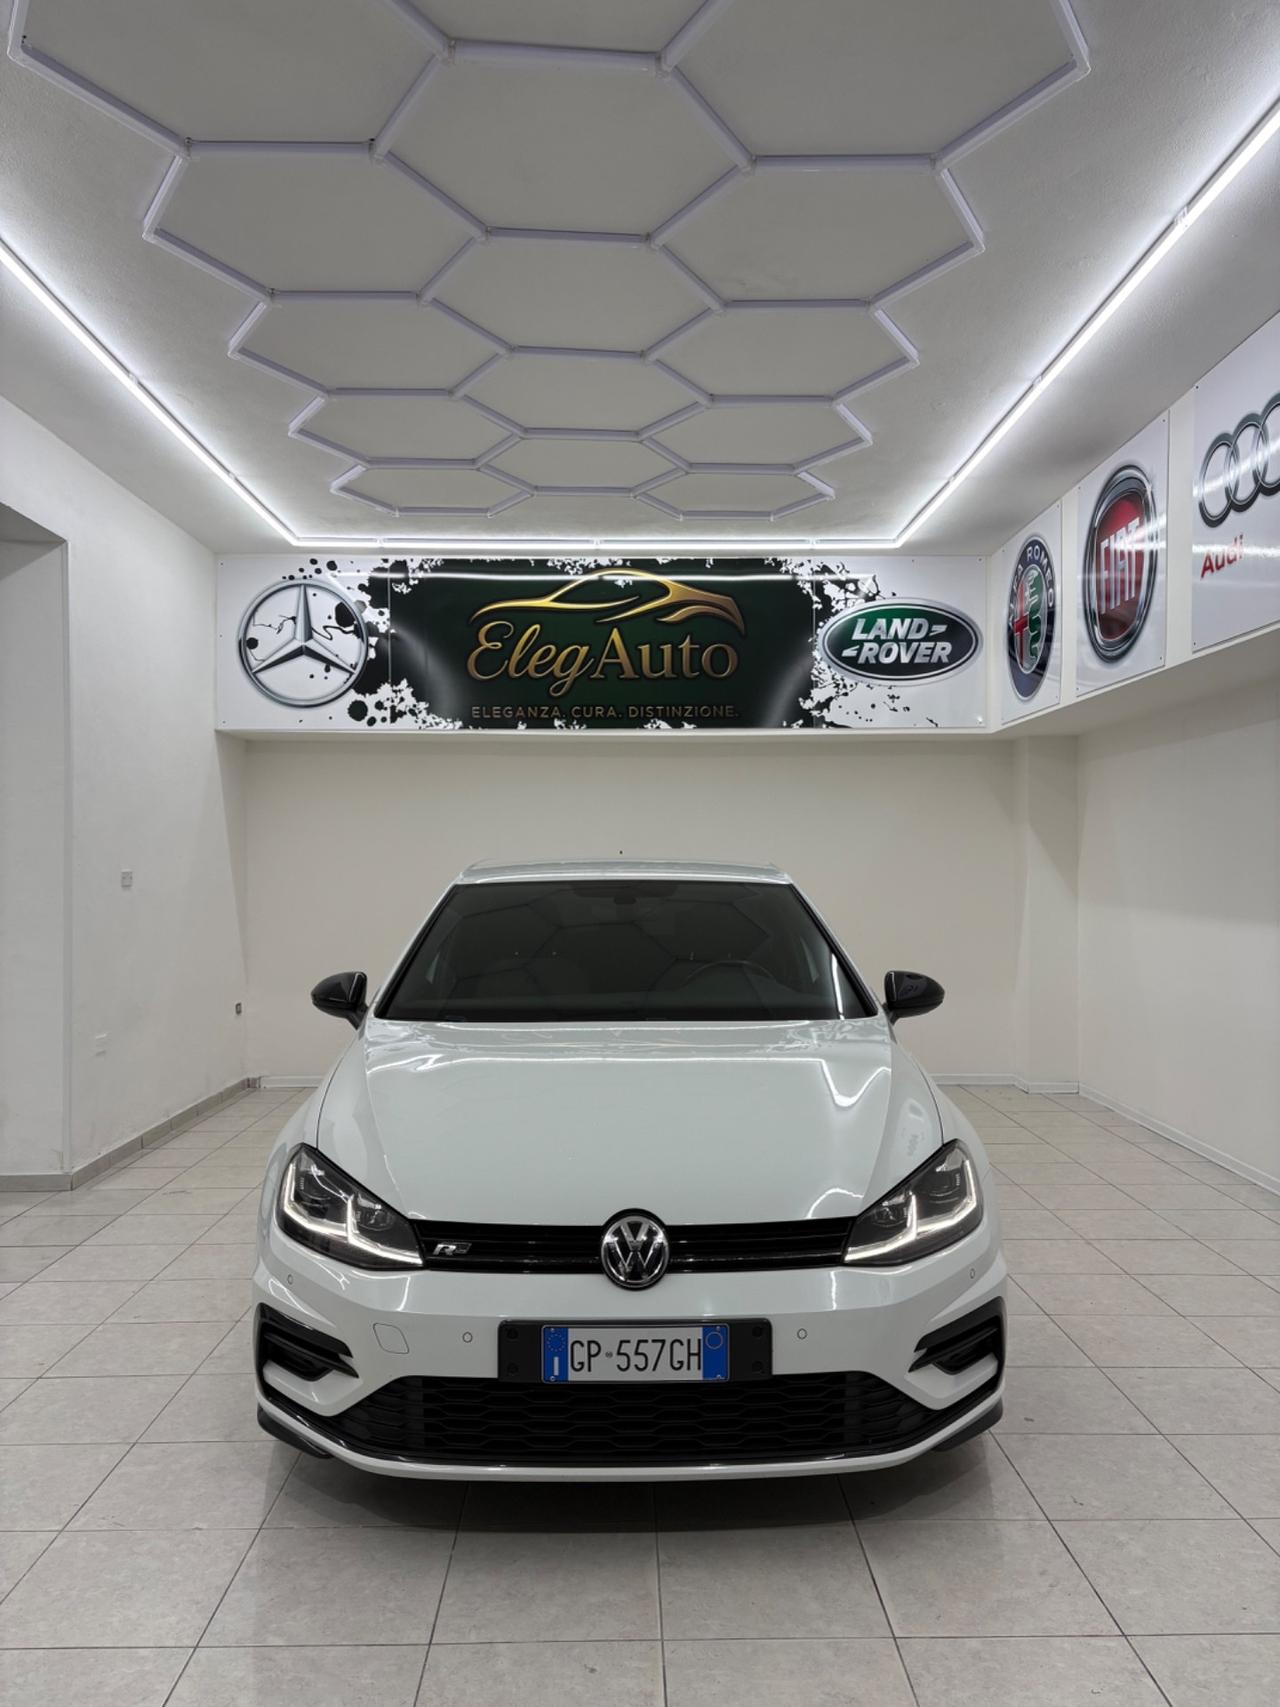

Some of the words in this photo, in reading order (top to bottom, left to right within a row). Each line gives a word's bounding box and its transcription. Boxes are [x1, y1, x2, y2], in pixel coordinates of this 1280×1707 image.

[1026, 544, 1054, 608] ROMEO
[1100, 516, 1140, 614] FIAT
[1201, 534, 1244, 579] Audi
[851, 618, 930, 640] LAND
[466, 620, 739, 697] ElegAuto
[857, 641, 953, 664] ROVER
[471, 705, 566, 719] ELEGANZA.
[571, 705, 622, 718] CURA.
[628, 704, 739, 718] DISTINZIONE.
[570, 1339, 602, 1373] GP
